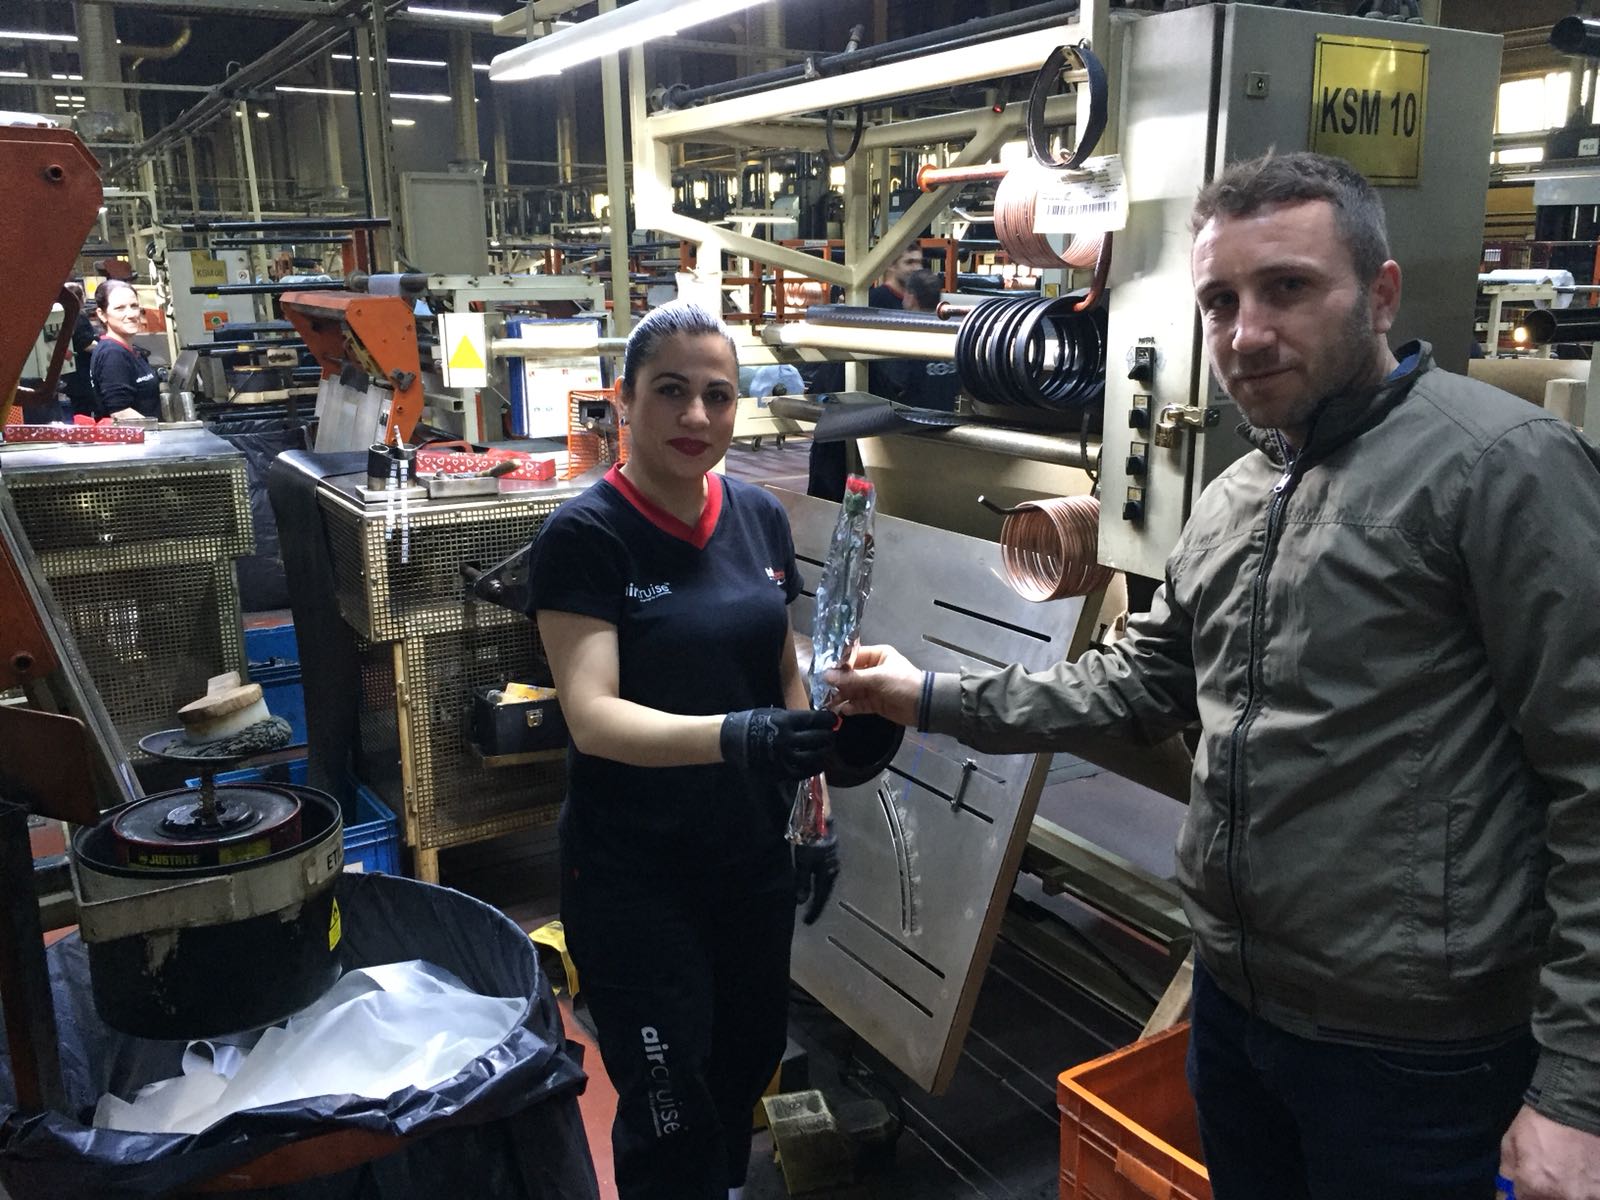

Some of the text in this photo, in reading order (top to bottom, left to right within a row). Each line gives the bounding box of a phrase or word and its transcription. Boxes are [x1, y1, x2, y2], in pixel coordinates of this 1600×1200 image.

[1321, 86, 1416, 137] KSM 10
[149, 853, 199, 865] JUSTRITE
